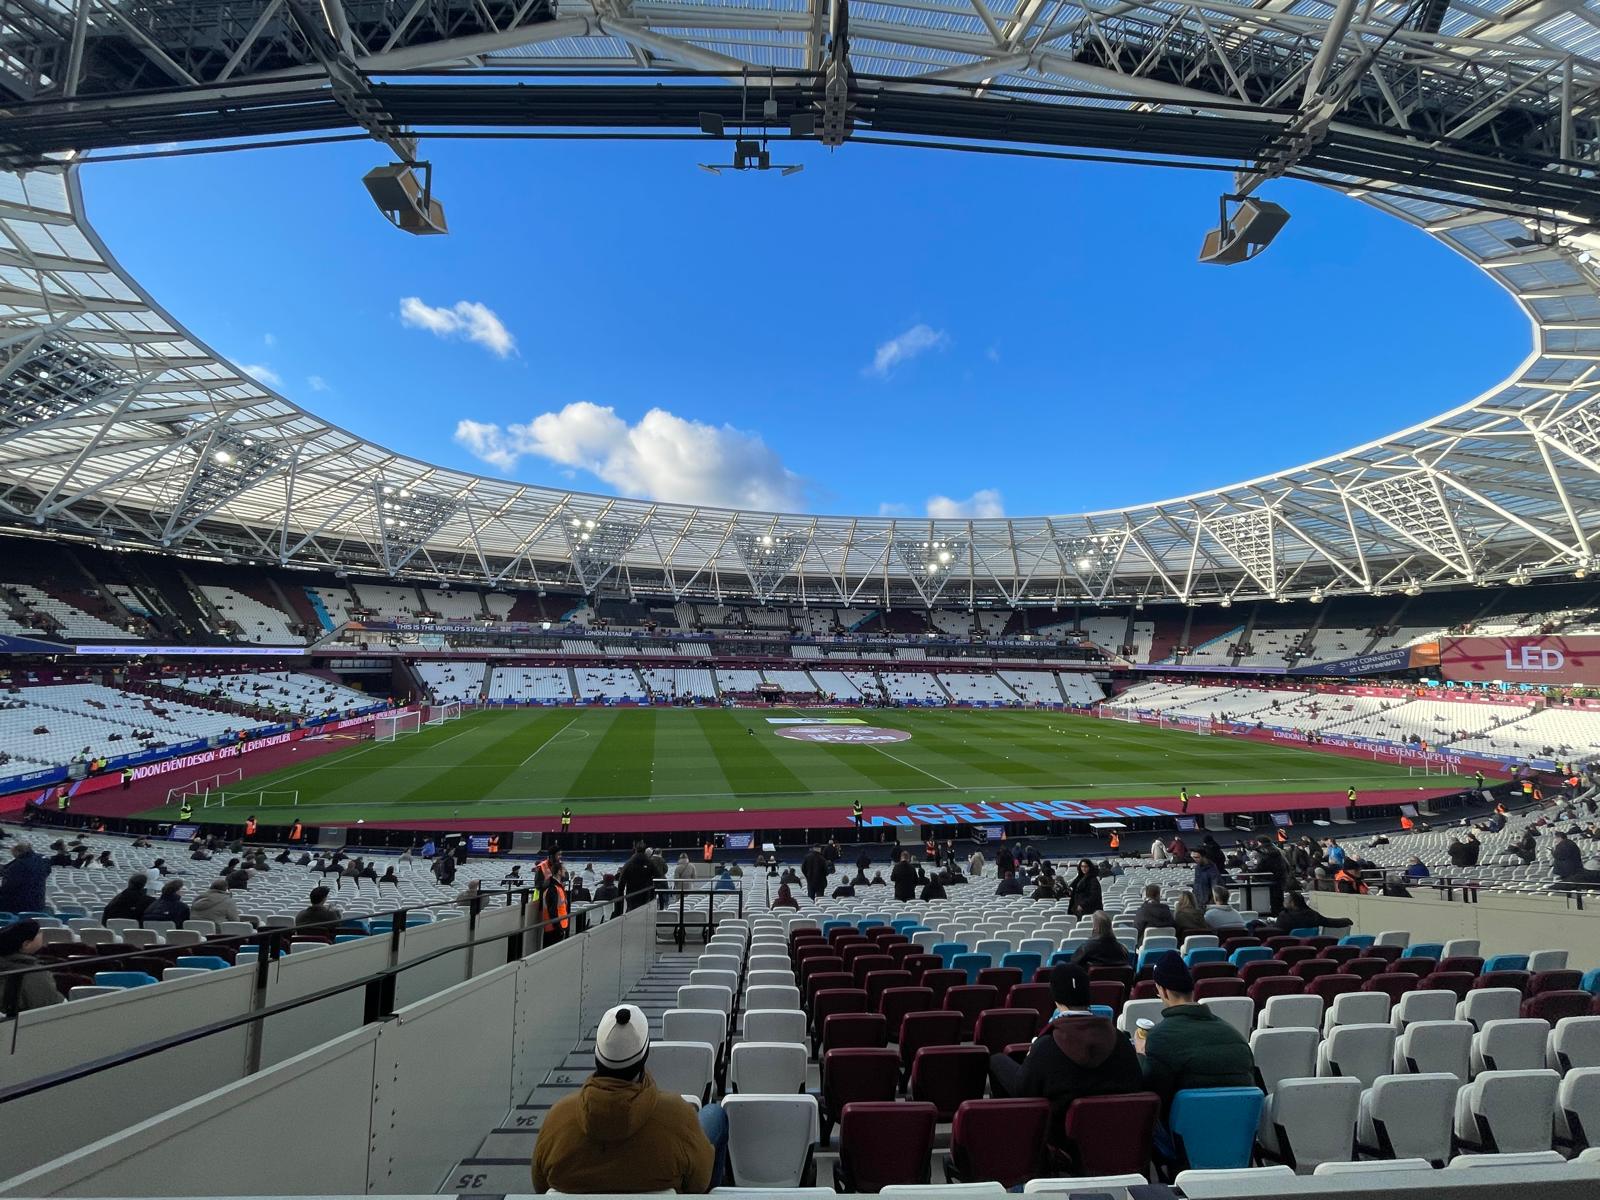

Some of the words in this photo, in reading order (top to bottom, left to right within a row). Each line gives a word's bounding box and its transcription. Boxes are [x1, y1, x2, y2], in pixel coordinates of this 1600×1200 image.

[1340, 659, 1359, 668] STAY
[1359, 651, 1405, 665] CONNECTED
[1505, 646, 1564, 670] LED
[161, 756, 188, 773] EVENT
[187, 749, 215, 767] DESIGN
[219, 743, 247, 759] OFFICL
[247, 739, 267, 752] EVENT
[266, 733, 291, 747] SUPPLIER
[1273, 731, 1300, 741] LONDON
[1322, 737, 1348, 747] DESIGN
[1353, 742, 1387, 754] OFFICIAL
[1389, 747, 1416, 758] EVENT
[1417, 751, 1461, 764] SUPPLIER
[906, 800, 1091, 815] UNITED
[516, 1115, 538, 1127] 34
[456, 1174, 487, 1189] 35
